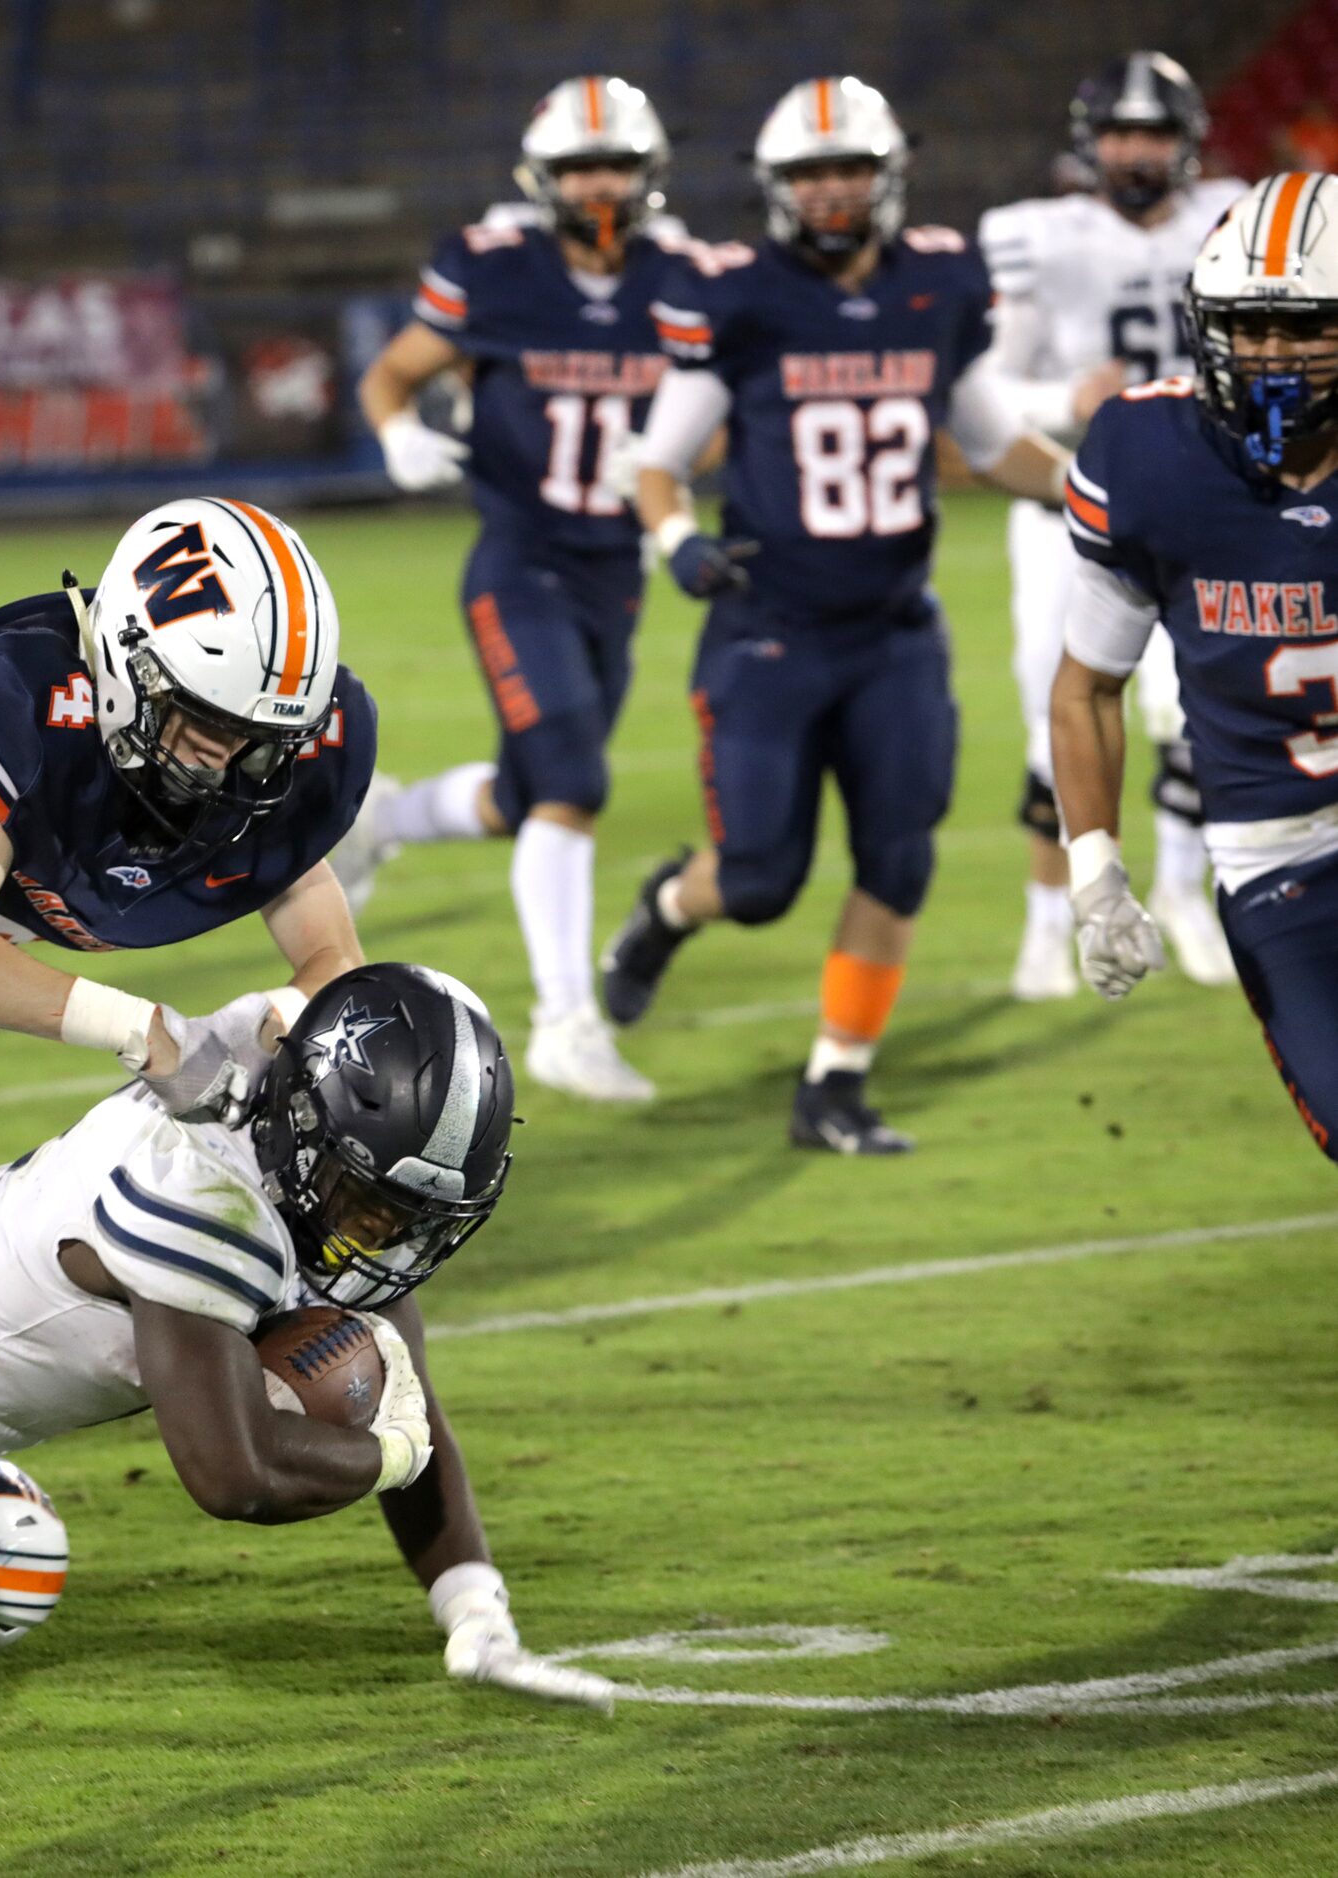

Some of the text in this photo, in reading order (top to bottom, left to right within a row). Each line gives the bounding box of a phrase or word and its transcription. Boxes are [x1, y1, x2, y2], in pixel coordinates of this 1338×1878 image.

[540, 396, 627, 515] 11
[792, 398, 930, 538] 82
[133, 521, 235, 630] W
[46, 672, 94, 729] 4
[273, 702, 305, 716] TEAM
[1264, 640, 1338, 780] 3
